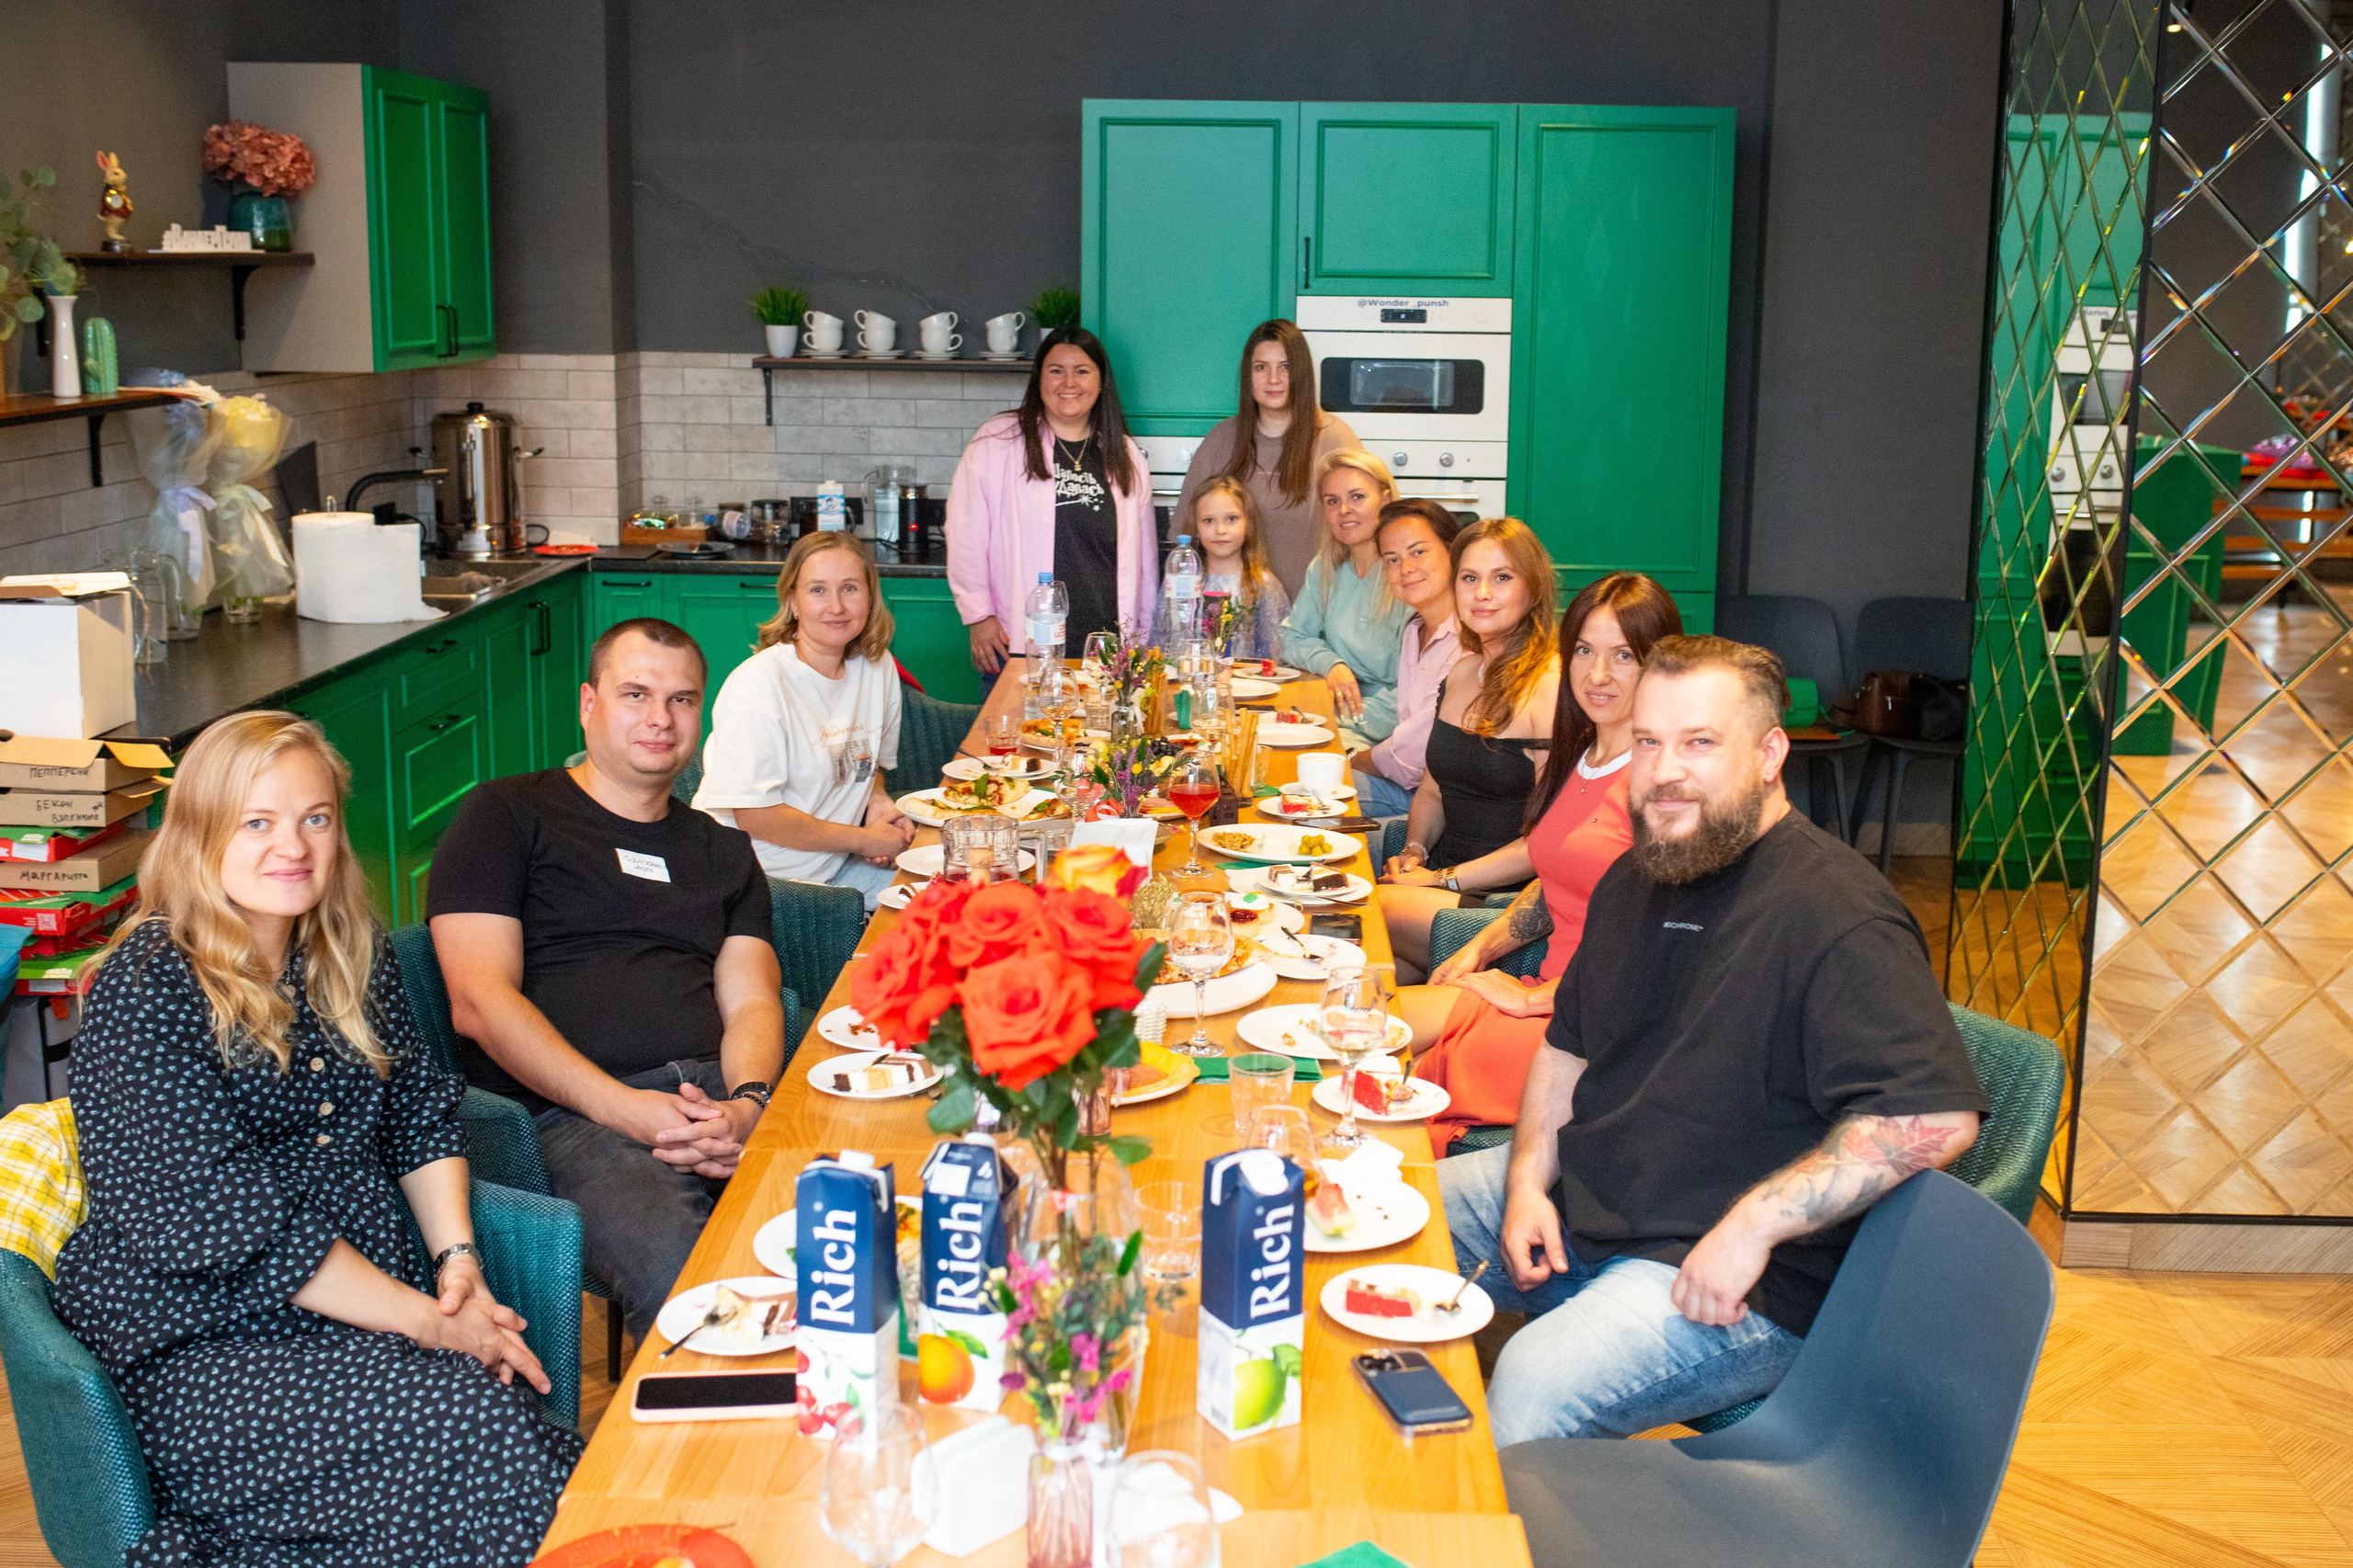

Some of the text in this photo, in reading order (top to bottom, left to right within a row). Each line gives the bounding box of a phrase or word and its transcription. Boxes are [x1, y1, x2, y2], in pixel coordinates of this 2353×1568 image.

[1358, 299, 1409, 308] @Wonder
[811, 1209, 857, 1326] Rich
[936, 1201, 983, 1312] Rich
[1250, 1203, 1294, 1320] Rich
